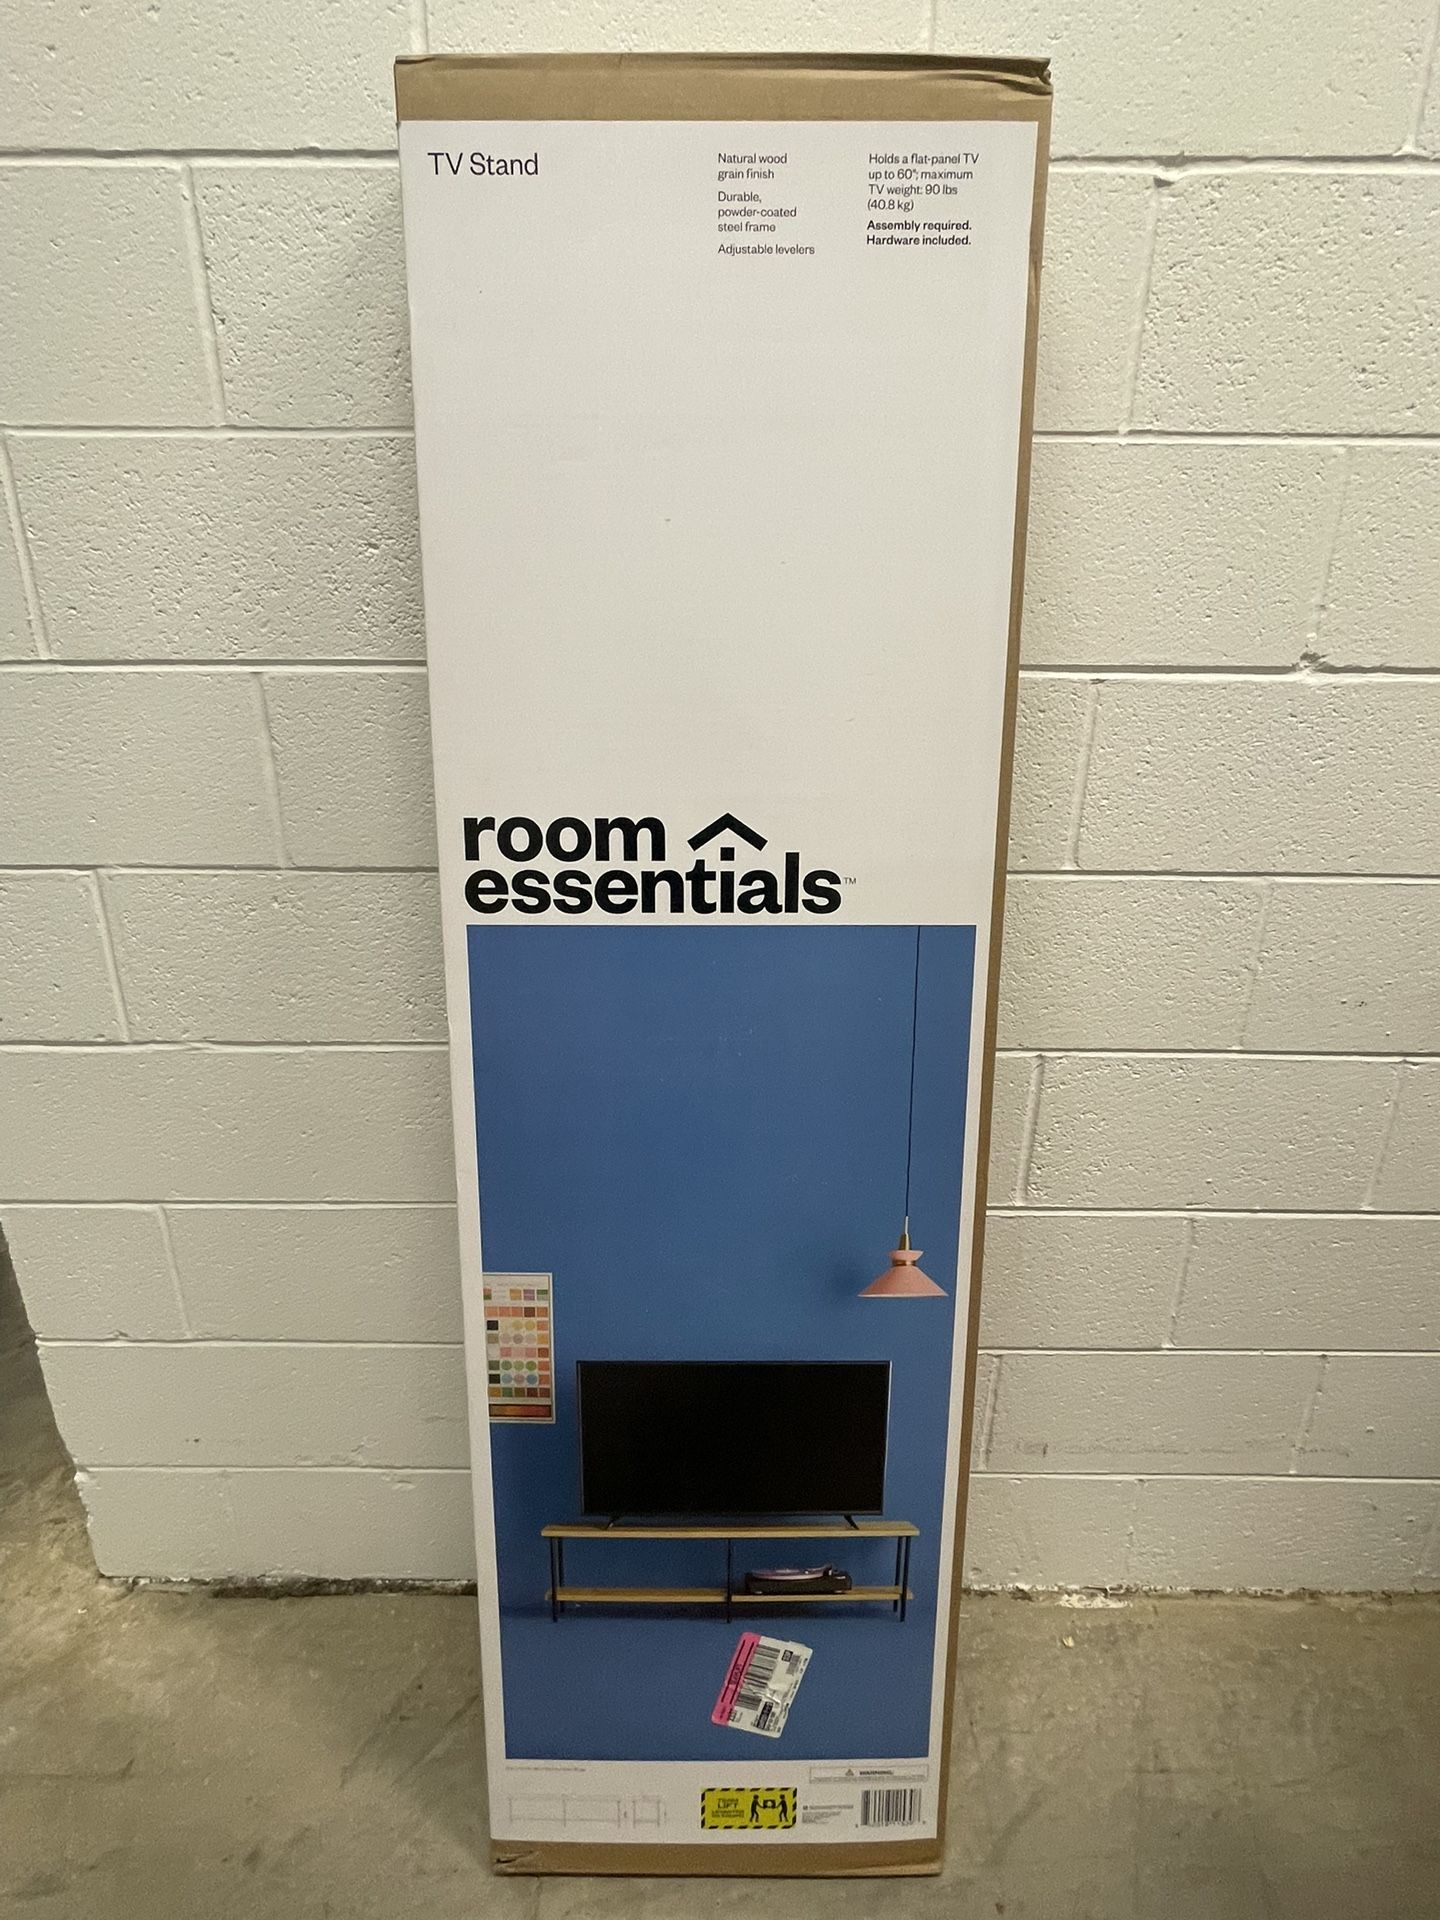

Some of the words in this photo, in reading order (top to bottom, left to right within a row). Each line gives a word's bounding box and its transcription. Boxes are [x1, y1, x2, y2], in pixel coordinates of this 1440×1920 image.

[427, 152, 463, 175] TV
[469, 152, 539, 177] Stand
[717, 153, 756, 165] Natural
[758, 153, 788, 165] wood
[869, 153, 900, 165] Holds
[902, 155, 909, 165] a
[911, 153, 961, 167] flat-panel
[963, 153, 981, 165] TV
[717, 168, 745, 182] grain
[746, 168, 775, 180] finish
[868, 171, 883, 182] up
[884, 169, 896, 180] to
[920, 168, 974, 181] maximum
[717, 190, 762, 204] Durable,
[869, 184, 885, 195] TV
[886, 184, 923, 197] weight:
[924, 184, 941, 196] 90
[942, 184, 958, 196] lbs
[867, 198, 896, 212] (40.8
[896, 198, 915, 213] kg)
[717, 206, 798, 220] powder-coated
[717, 222, 743, 233] steel
[744, 221, 777, 233] frame
[867, 219, 921, 233] Assembly
[922, 219, 973, 233] required.
[866, 234, 921, 246] Hardware
[922, 234, 973, 246] included.
[717, 244, 774, 256] Adjustable
[775, 244, 816, 255] levelers
[463, 816, 667, 863] room
[464, 846, 842, 914] essentials
